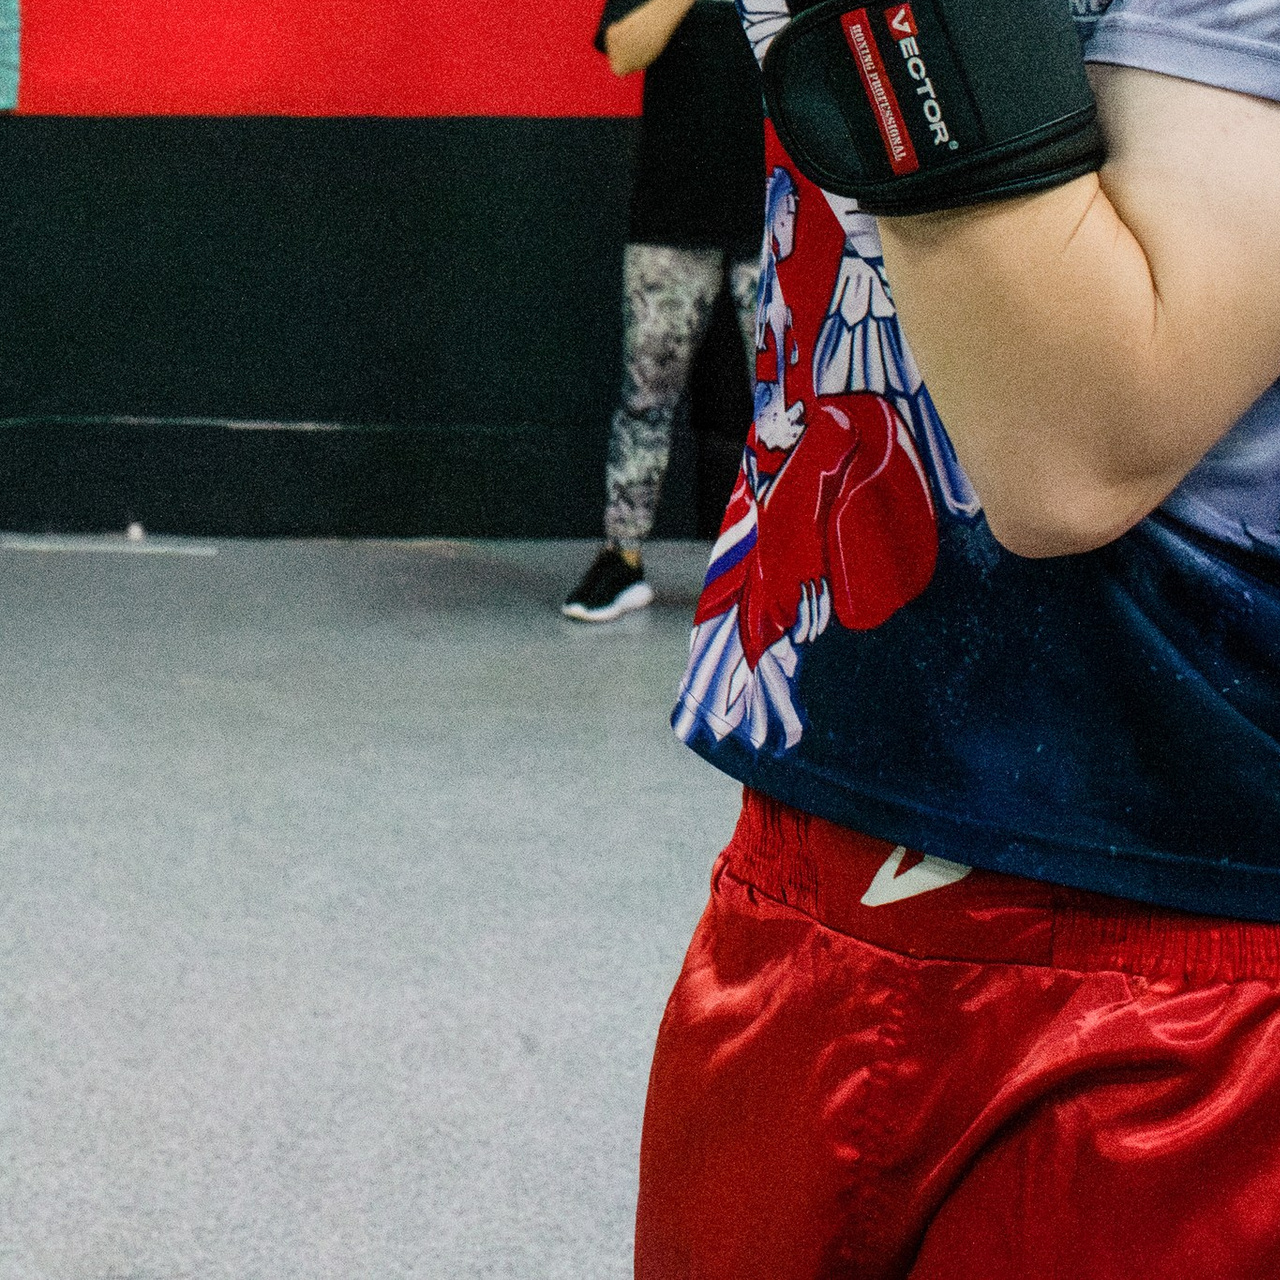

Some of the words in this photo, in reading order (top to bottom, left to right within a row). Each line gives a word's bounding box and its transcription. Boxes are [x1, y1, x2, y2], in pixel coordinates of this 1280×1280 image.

[849, 23, 876, 71] BOXING
[869, 71, 907, 162] PROFESSIONAL
[891, 8, 950, 146] VECTOR
